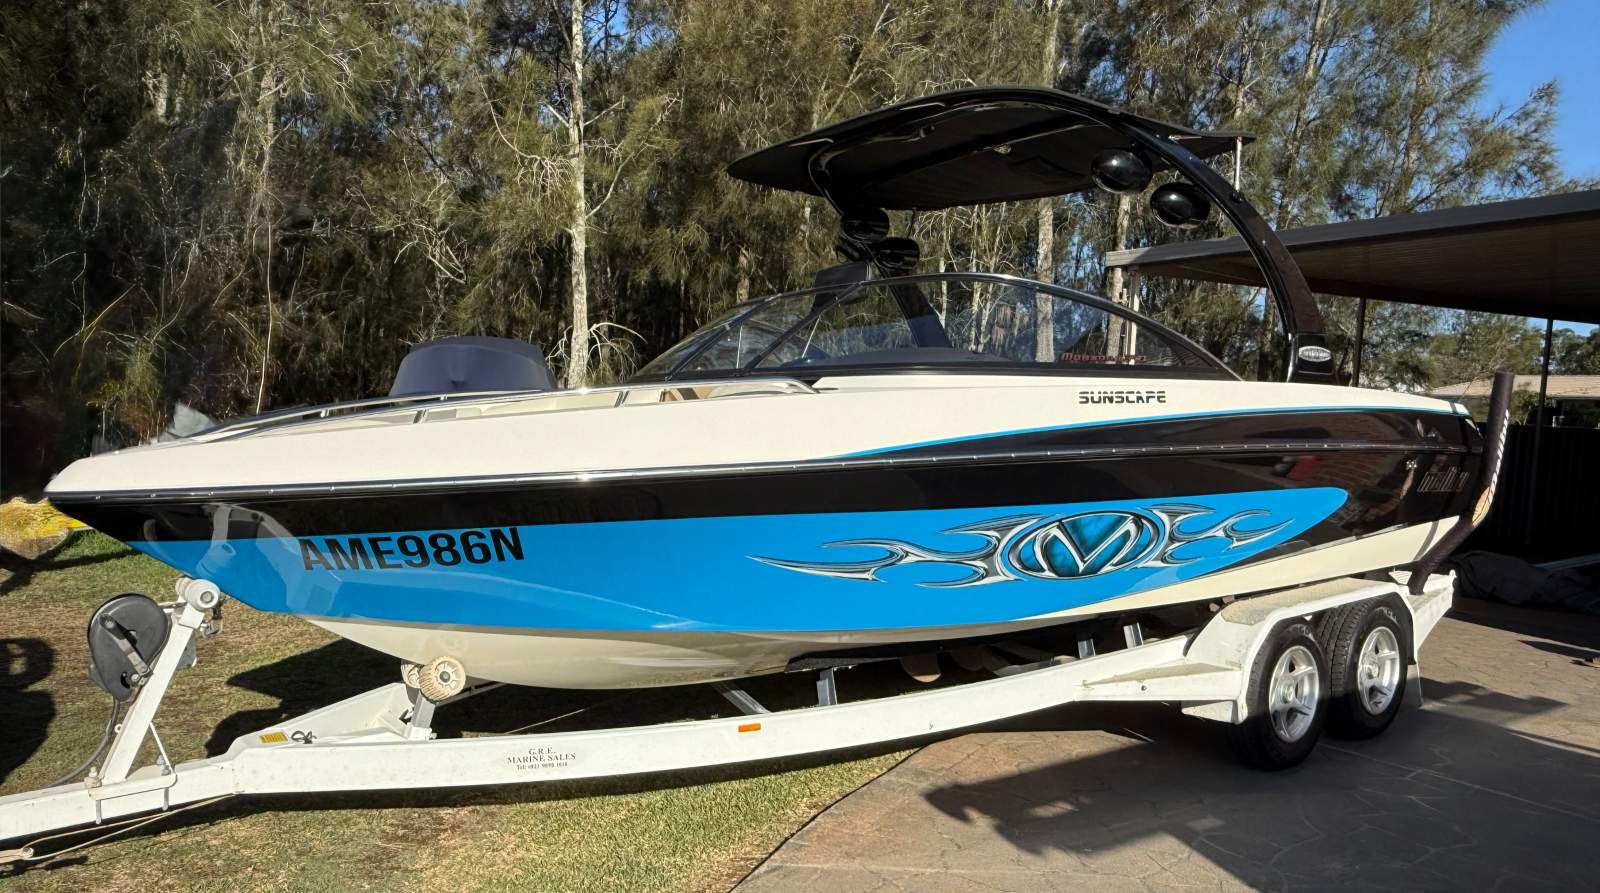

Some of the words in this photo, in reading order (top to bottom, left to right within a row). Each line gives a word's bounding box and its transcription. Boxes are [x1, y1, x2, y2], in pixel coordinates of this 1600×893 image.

[1078, 390, 1167, 404] SUNSCAPE
[298, 527, 524, 571] AME986N
[507, 754, 546, 764] MARINE
[547, 752, 576, 761] SALES
